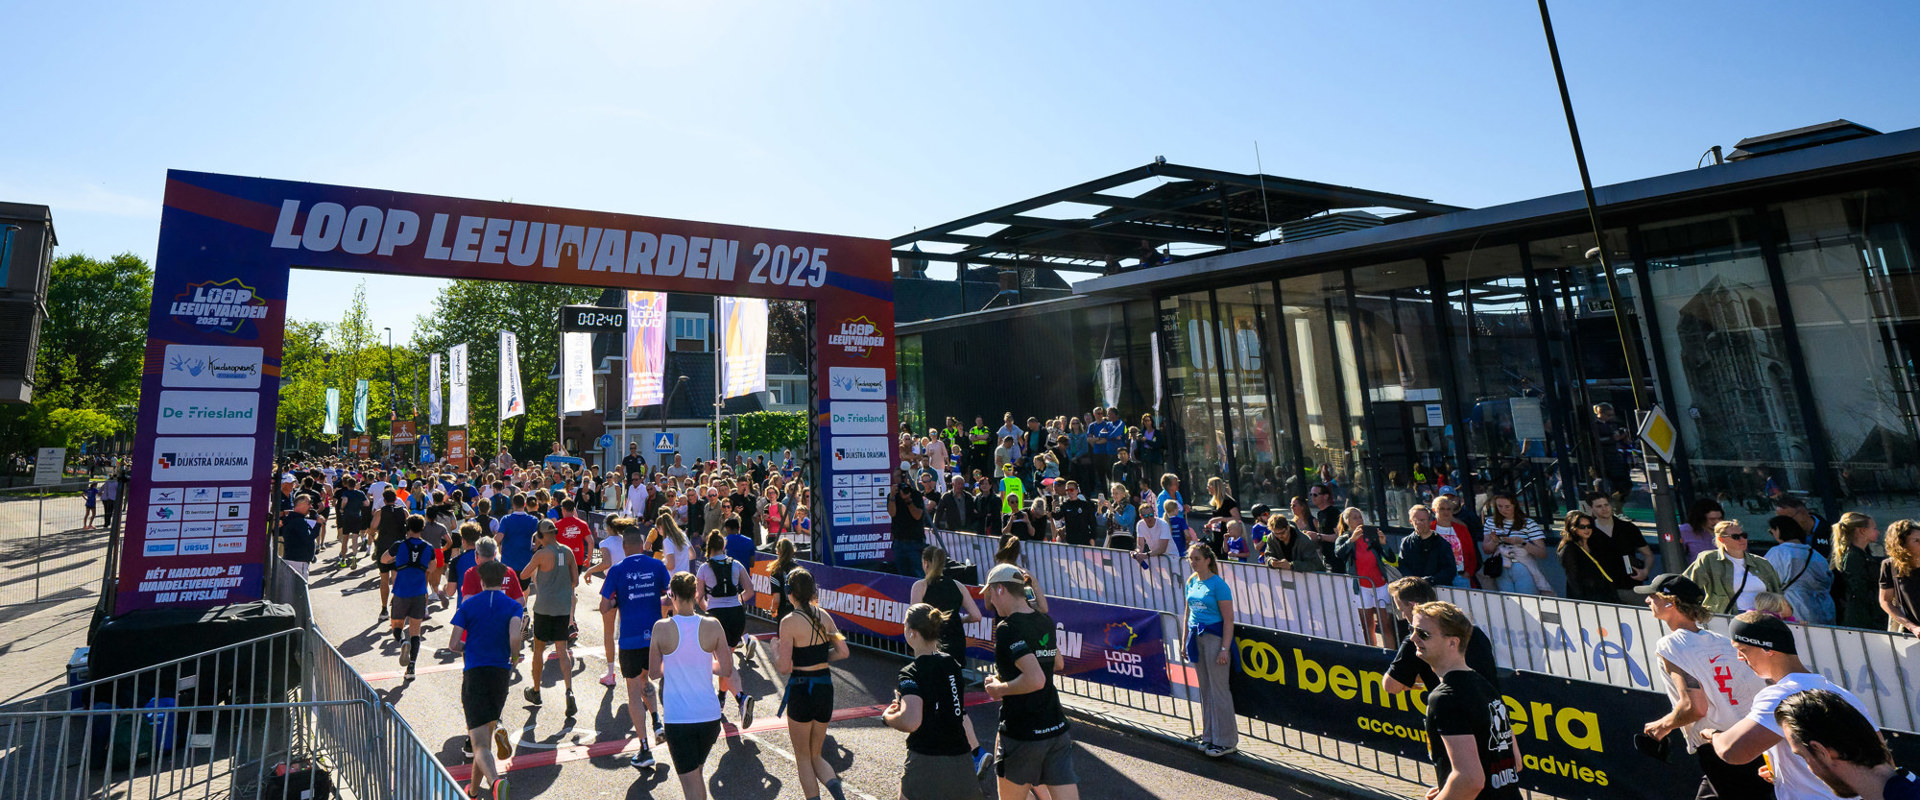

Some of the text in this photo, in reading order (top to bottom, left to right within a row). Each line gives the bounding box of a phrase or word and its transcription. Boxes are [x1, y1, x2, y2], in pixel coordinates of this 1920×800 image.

[271, 199, 829, 288] LOOP LEEUWARDEN 2025
[193, 287, 253, 304] LOOP
[169, 302, 269, 319] LEEUWARDEN
[631, 310, 661, 319] LOOP
[196, 317, 219, 325] 2025
[841, 323, 874, 335] LOOP
[828, 334, 885, 347] LEEUWARDEN
[163, 406, 253, 418] De Friesland
[833, 413, 885, 423] De Friesland
[177, 457, 248, 466] DIJKSTRA DRAISMA
[423, 450, 428, 458] P
[145, 565, 242, 580] HÉT HARDLOOP- EN
[138, 577, 244, 592] WANDELEVENEMENT
[155, 587, 229, 603] VAN FRYSLÂN!
[818, 588, 909, 625] WANDELEVENE
[1734, 634, 1773, 648] ROGUE
[1104, 649, 1142, 665] LOOP
[1106, 660, 1144, 678] LWD
[1522, 753, 1609, 787] advies
